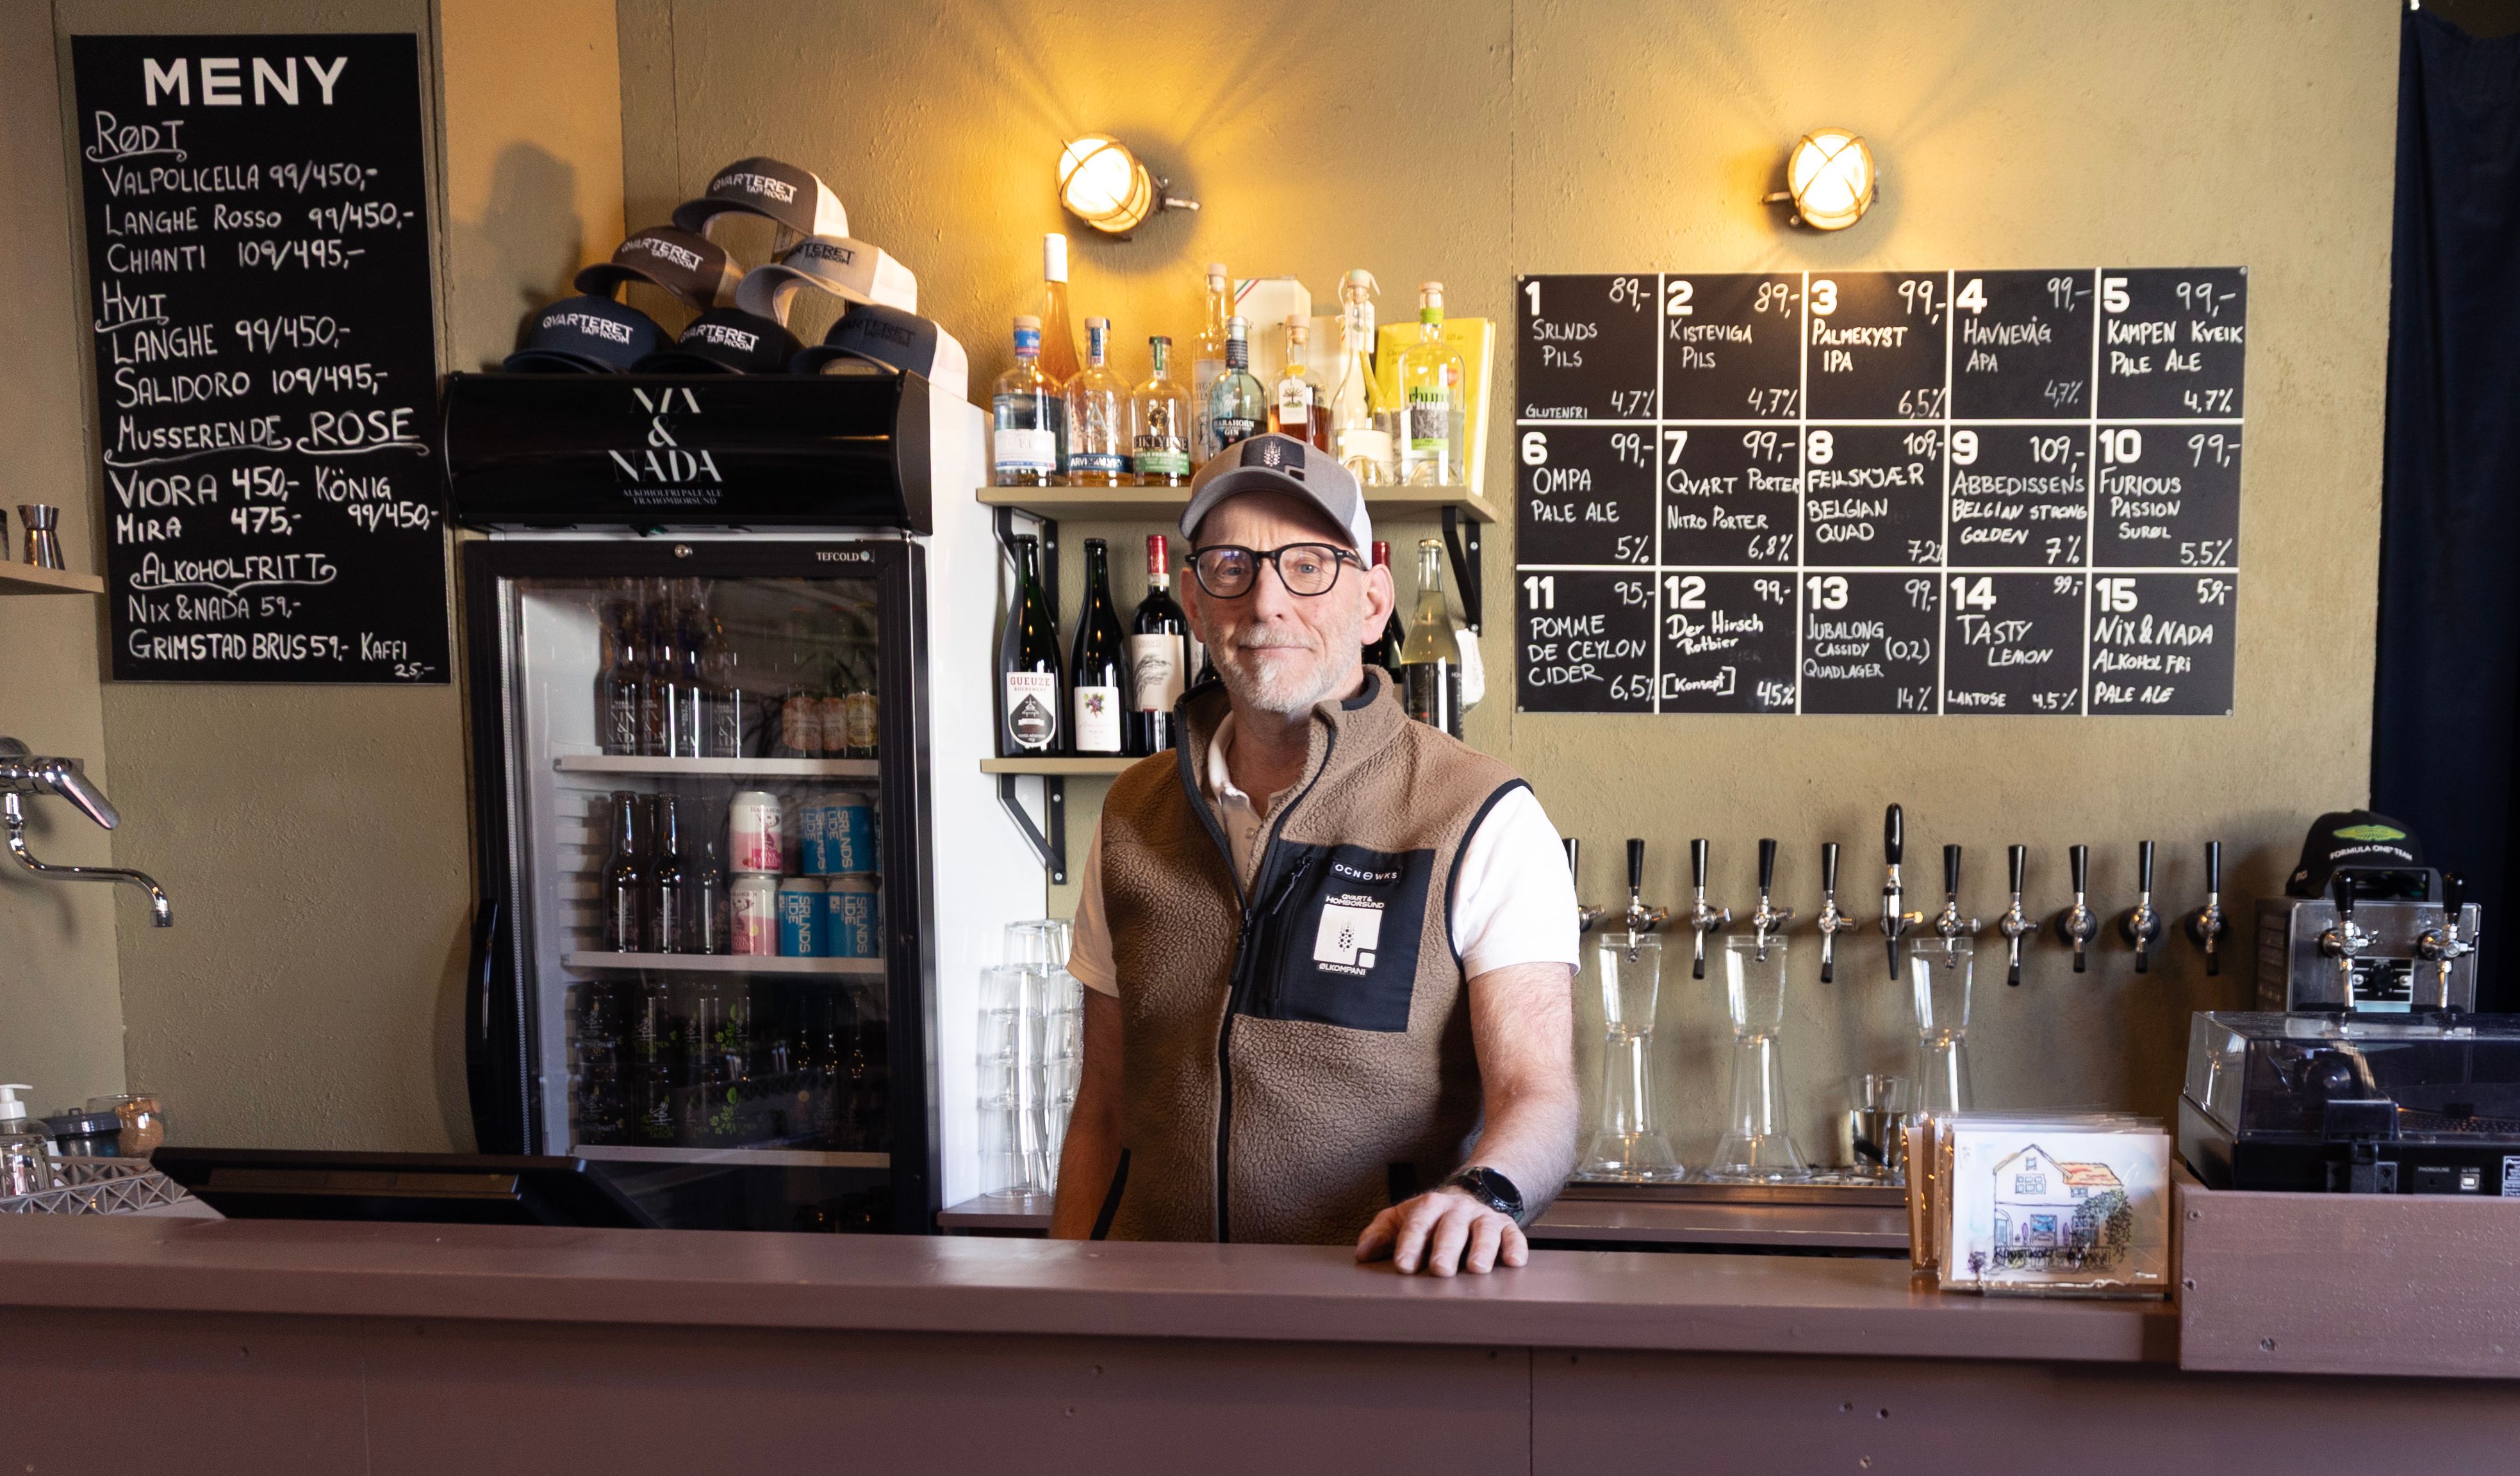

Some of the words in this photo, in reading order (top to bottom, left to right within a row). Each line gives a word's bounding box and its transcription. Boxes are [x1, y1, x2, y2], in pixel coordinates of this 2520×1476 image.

[143, 56, 348, 106] MENY
[95, 110, 185, 157] RØDT
[103, 164, 259, 197] VALPOLICELLA
[269, 160, 378, 193] 99/450,-
[106, 204, 198, 236] LANGHE
[309, 201, 414, 234] 99/450,-
[108, 243, 205, 274] CHIANTI
[238, 240, 365, 270] 109/495,-
[103, 280, 168, 323] HVIT
[1525, 281, 1540, 316] 1
[1667, 281, 1693, 316] 2
[1811, 279, 1838, 315] 3
[1956, 278, 1988, 314] 4
[2103, 277, 2130, 313] 5
[113, 324, 217, 365] LANGHE
[236, 316, 350, 354] 99/450,-
[543, 313, 634, 340] QVARTERET
[1533, 318, 1597, 340] SRLNDS
[1669, 318, 1753, 345] KISTEVIGA
[1811, 318, 1908, 347] PALMEKYST
[1963, 316, 2052, 345] HAVNEVÅG
[2107, 320, 2177, 345] KAMPEN
[1542, 345, 1583, 368] PILS
[1681, 346, 1716, 370] PILS
[1823, 350, 1854, 373] IPA
[1966, 350, 1998, 373] APA
[2111, 350, 2152, 375] PALE
[2164, 348, 2202, 373] ALE
[115, 368, 250, 407] SALIDORO
[272, 364, 388, 396] 109/495,-
[1526, 404, 1588, 419] GLUTENFRI
[118, 415, 283, 452] MUSSERENDE
[310, 407, 420, 447] ROSE
[648, 415, 677, 447] &
[1522, 430, 1547, 464] 6
[1664, 430, 1688, 464] 7
[1807, 430, 1834, 464] 8
[1951, 430, 1979, 464] 9
[2098, 429, 2142, 464] 10
[608, 450, 723, 482] NADA
[109, 469, 218, 508] VIORA
[233, 468, 300, 501] 450,-
[315, 466, 391, 501] KÖNIG
[1533, 467, 1592, 495] OMPA
[1667, 470, 1738, 496] QVART
[1747, 468, 1800, 493] PORTER
[1951, 470, 2085, 496] ABBEDISSENS
[2100, 467, 2182, 496] FURIOUS
[1531, 500, 1576, 523] PALE
[1585, 501, 1620, 523] ALE
[1667, 505, 1707, 531] NITRO
[1712, 506, 1769, 530] PORTER
[1807, 498, 1888, 523] BELGIAN
[1952, 498, 2024, 522] BELGIAN
[2029, 504, 2088, 521] STRONG
[2111, 498, 2180, 520] PASSION
[117, 513, 182, 544] MIRA
[231, 507, 302, 535] 475,-
[1816, 522, 1875, 543] QUAD
[1961, 527, 2029, 545] GOLDEN
[816, 552, 859, 562] TEFCOLD
[1615, 535, 1649, 564] 5%
[142, 552, 326, 584] ALKOHOLFRITT
[1524, 576, 1554, 609] 11
[1664, 575, 1706, 609] 12
[1806, 576, 1849, 609] 13
[1950, 577, 1997, 611] 14
[2095, 577, 2138, 612] 15
[260, 595, 301, 619] 59,-
[1531, 615, 1605, 640] POMME
[1666, 614, 1705, 641] Der
[1712, 609, 1764, 633] Hirsch
[1807, 613, 1884, 641] JUBALONG
[1956, 614, 2034, 646] TASTY
[129, 628, 247, 660] GRIMSTAD
[252, 636, 308, 660] BRUS
[361, 632, 408, 660] KAFFI
[1528, 643, 1558, 663] DE
[1568, 639, 1646, 661] CEYLON
[1815, 642, 1870, 659] CASSIDY
[1988, 648, 2054, 667] LEMON
[1010, 676, 1050, 686] GUEUZE
[1528, 664, 1604, 688] CIDER
[1804, 658, 1884, 680] QUADLAGER
[1947, 689, 2006, 707] LAKTOSE
[2095, 681, 2134, 705] PALE
[2140, 685, 2175, 703] ALE
[827, 810, 839, 840] LIDE
[838, 810, 853, 868] SRLNDS
[2329, 845, 2371, 860] FORMULA
[789, 895, 798, 924] LIDE
[845, 896, 856, 924] LIDE
[1326, 896, 1385, 908] HOMBORSUND
[799, 896, 811, 953] SRLNDS
[856, 897, 868, 953] SRLNDS
[1319, 963, 1366, 976] ØLKOMPANI
